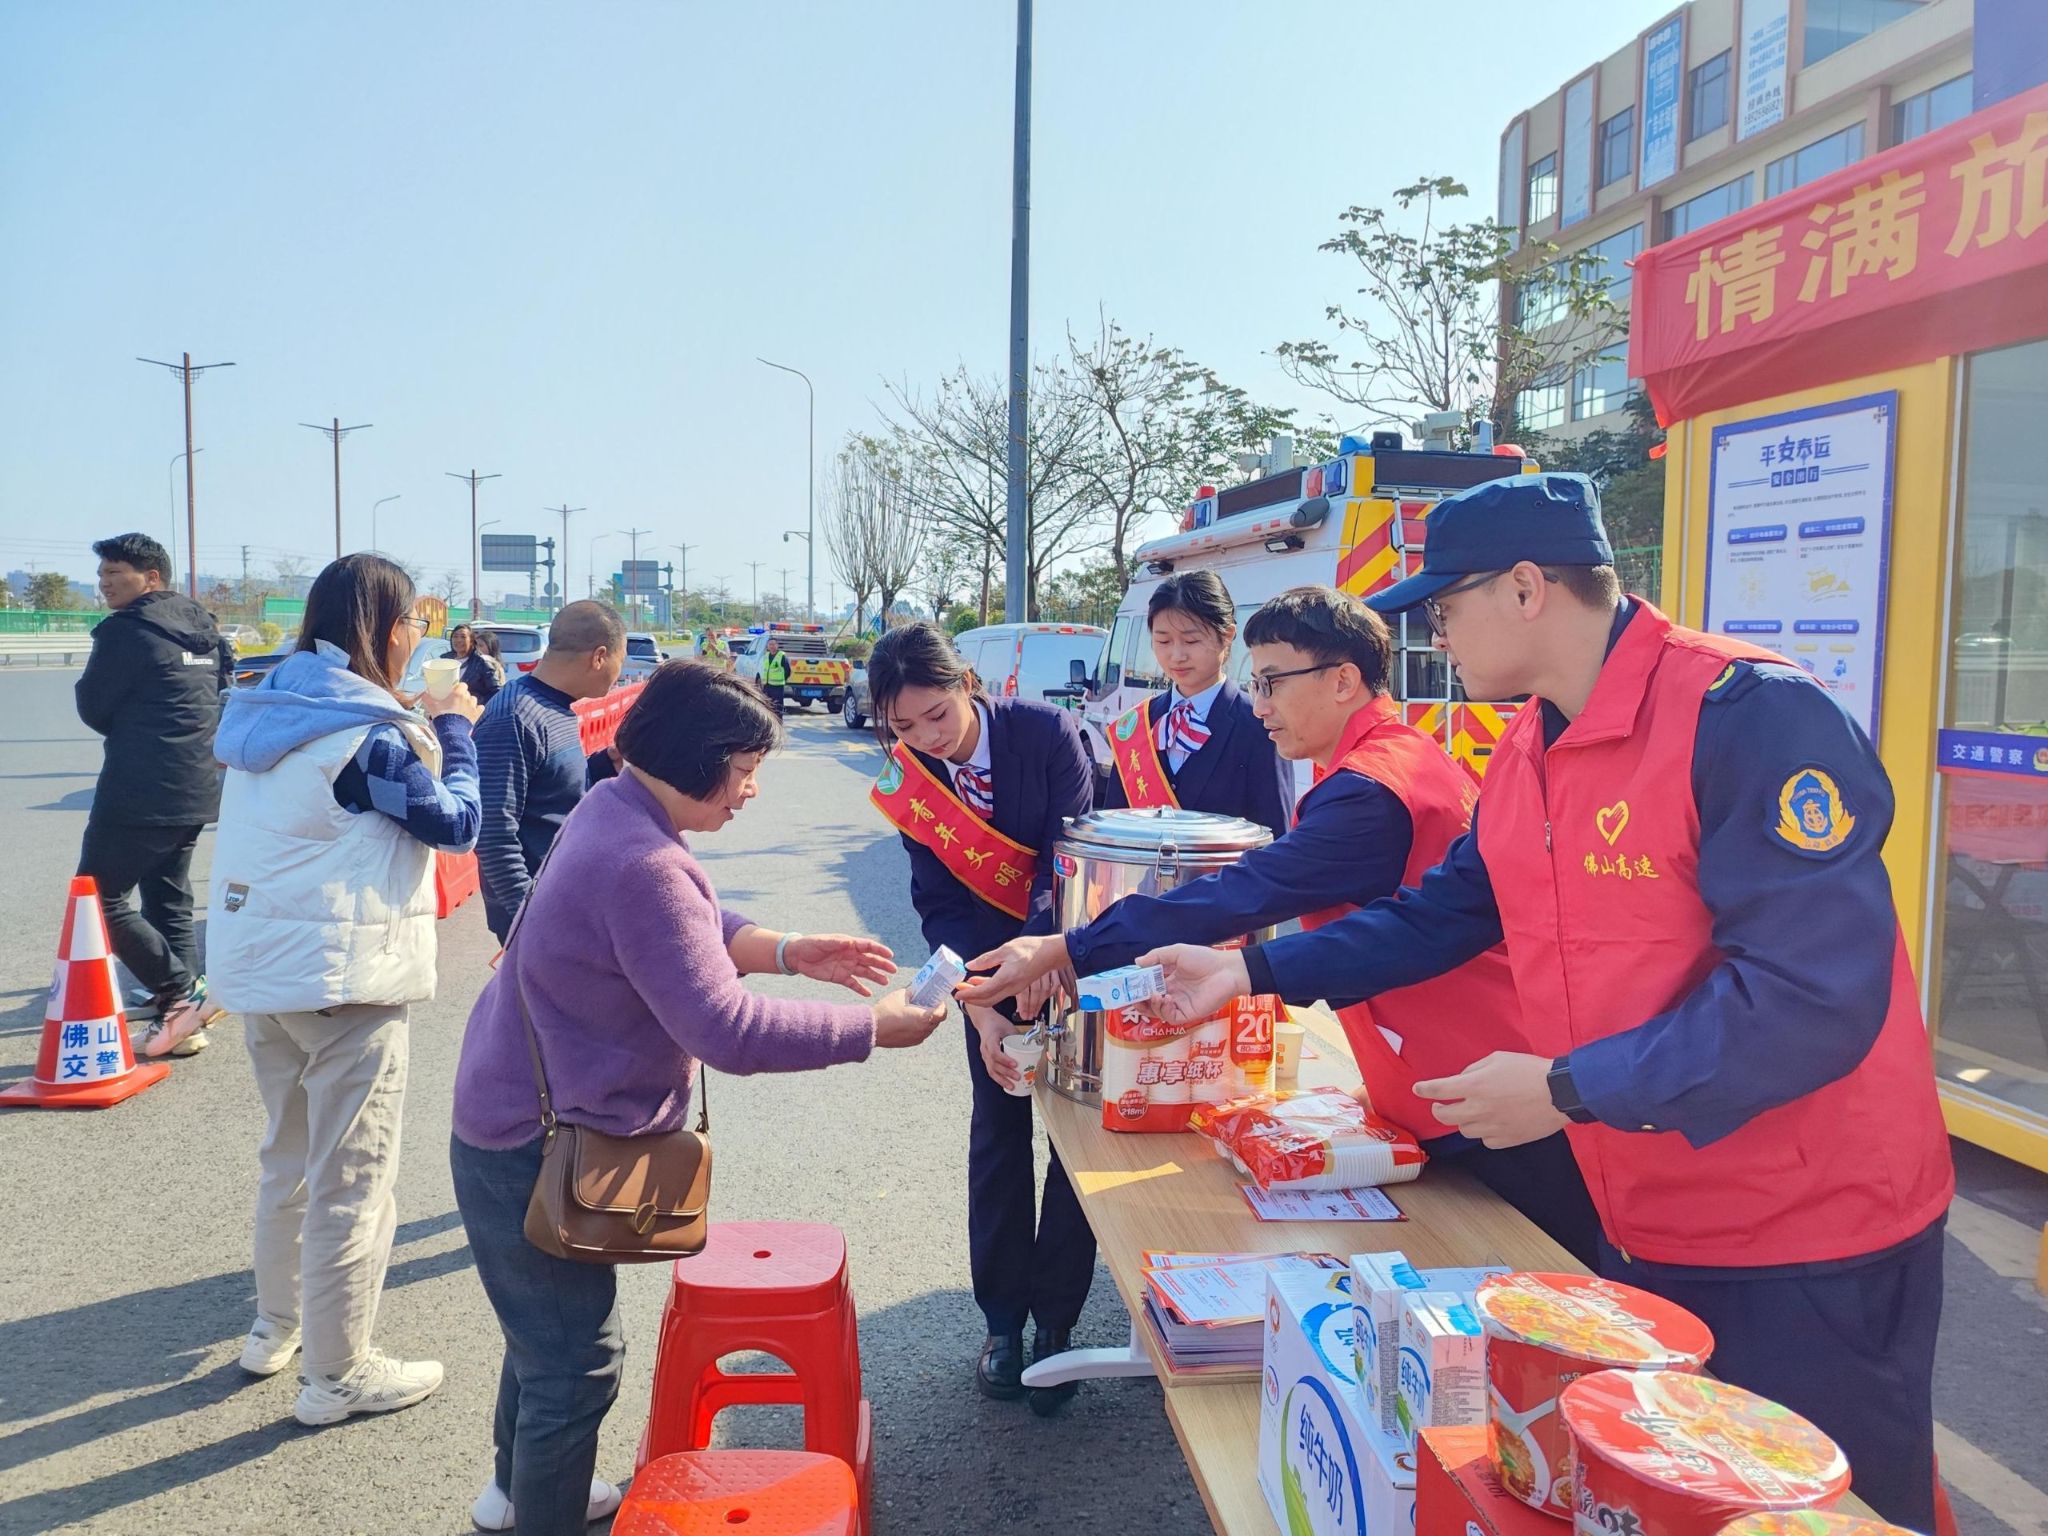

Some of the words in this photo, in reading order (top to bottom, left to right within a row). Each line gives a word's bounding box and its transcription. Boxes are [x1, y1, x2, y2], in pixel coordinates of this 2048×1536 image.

[1772, 467, 1819, 487] 安全出行
[1952, 743, 2023, 766] 交通警察
[1129, 748, 1154, 808] 青年
[909, 798, 1033, 892] 青年文明
[1583, 851, 1659, 881] 佛山高速
[62, 1022, 118, 1049] 佛山
[1142, 1027, 1187, 1037] CHAHUA
[1236, 1012, 1271, 1043] 20
[62, 1050, 120, 1079] 交警
[1136, 1060, 1224, 1086] 惠享纸杯
[1299, 1403, 1343, 1527] 纯牛奶
